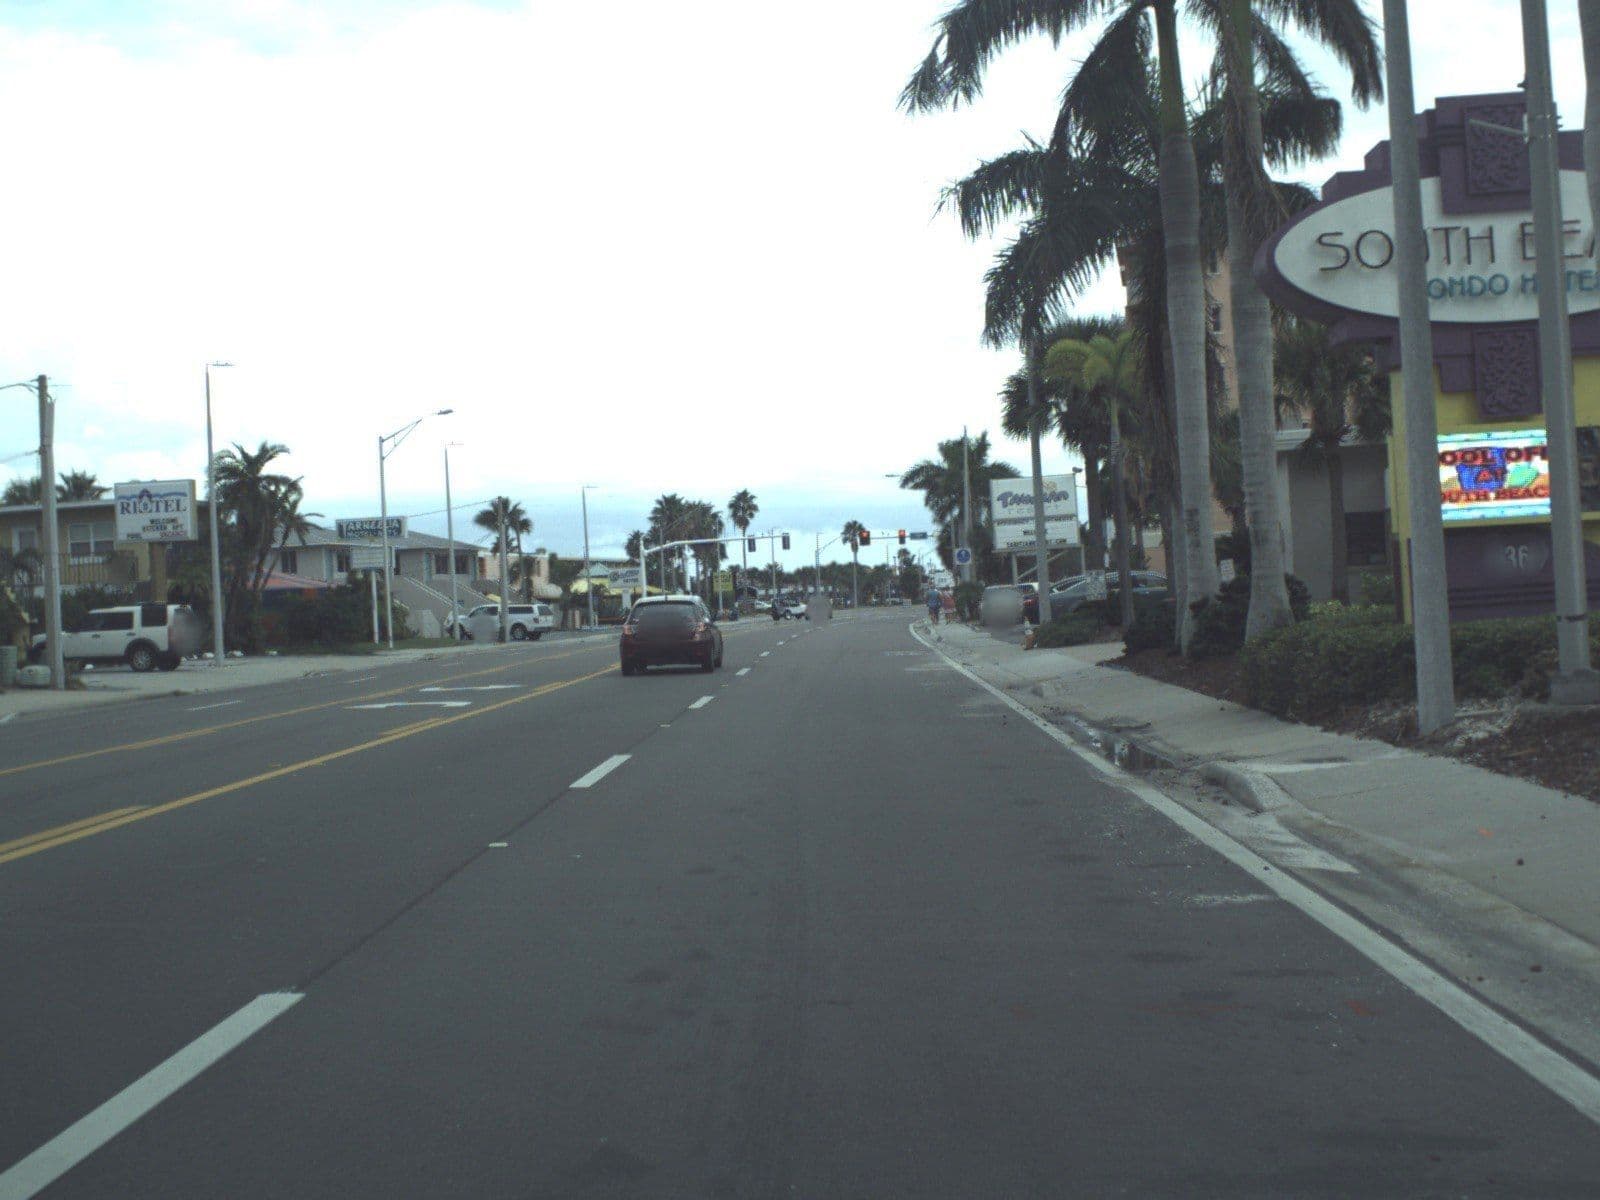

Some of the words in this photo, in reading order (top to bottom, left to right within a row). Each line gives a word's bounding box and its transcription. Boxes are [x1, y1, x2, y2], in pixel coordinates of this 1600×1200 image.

[1316, 224, 1495, 271] SOTH
[1427, 273, 1509, 299] ONDO
[1440, 448, 1497, 465] OOL
[1496, 485, 1549, 499] BEAC
